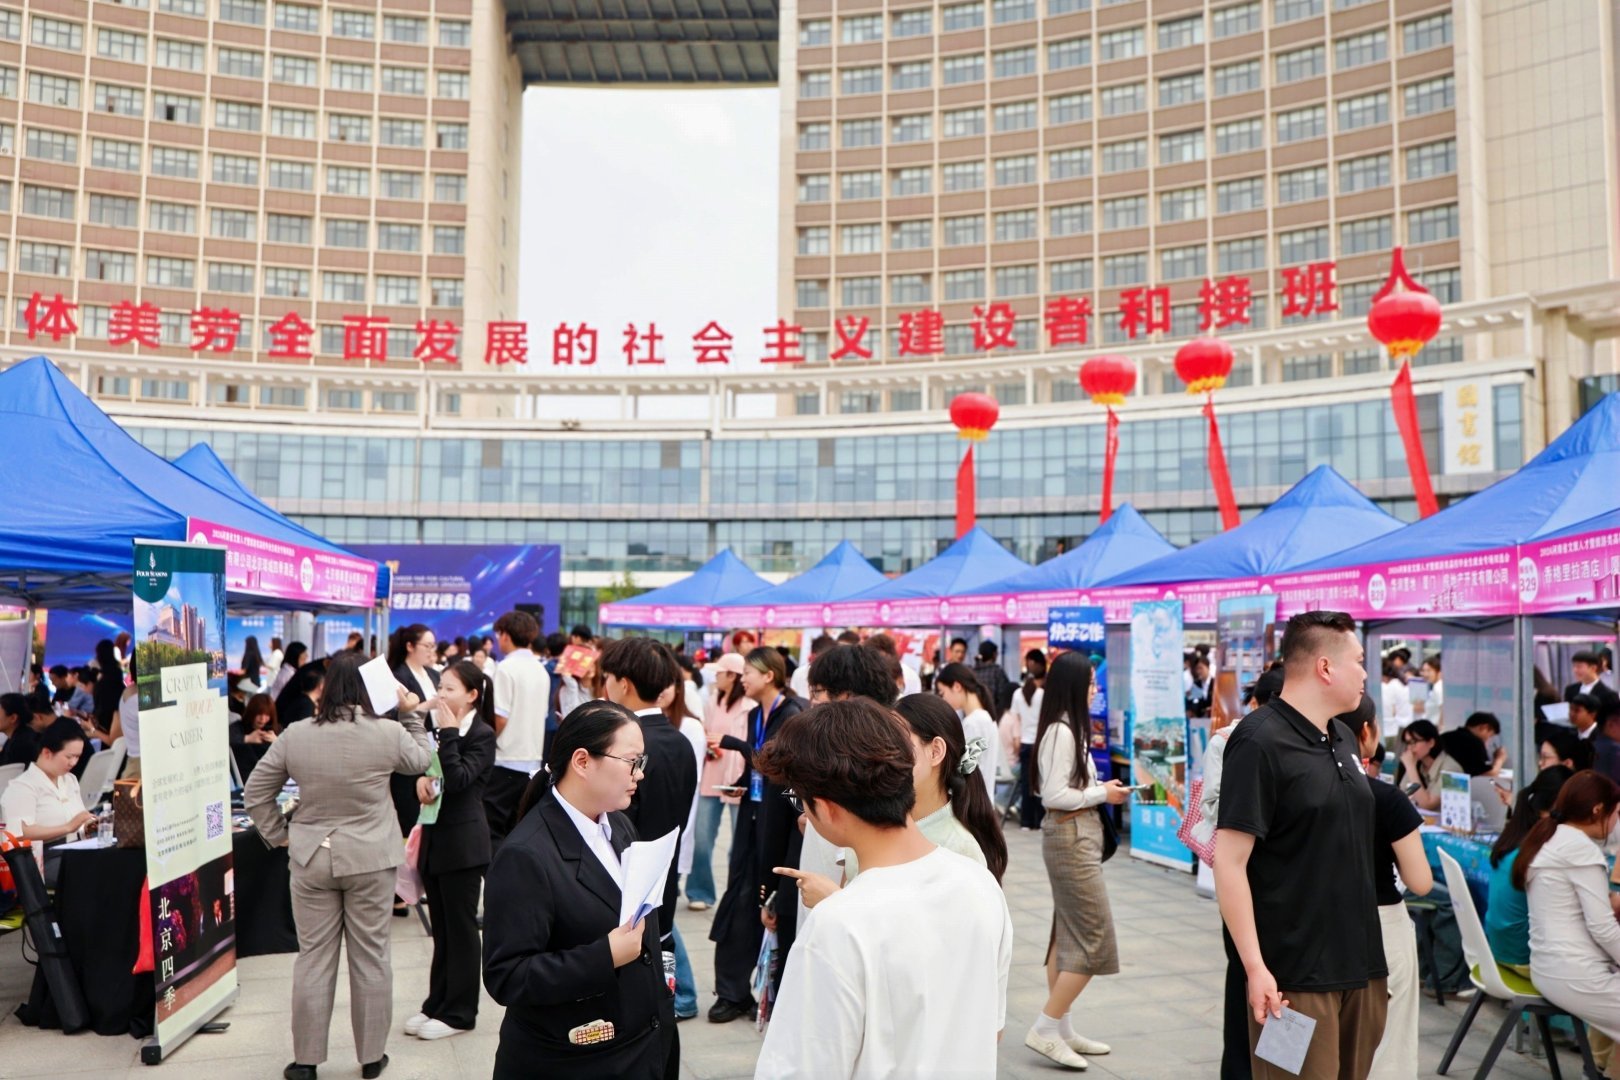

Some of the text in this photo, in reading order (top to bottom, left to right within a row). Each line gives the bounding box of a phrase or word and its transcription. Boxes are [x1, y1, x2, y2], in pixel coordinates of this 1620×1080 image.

[25, 247, 1430, 366] 体美劳全面发展的社会主义建设者和接班人
[157, 896, 176, 1011] 北京四季
